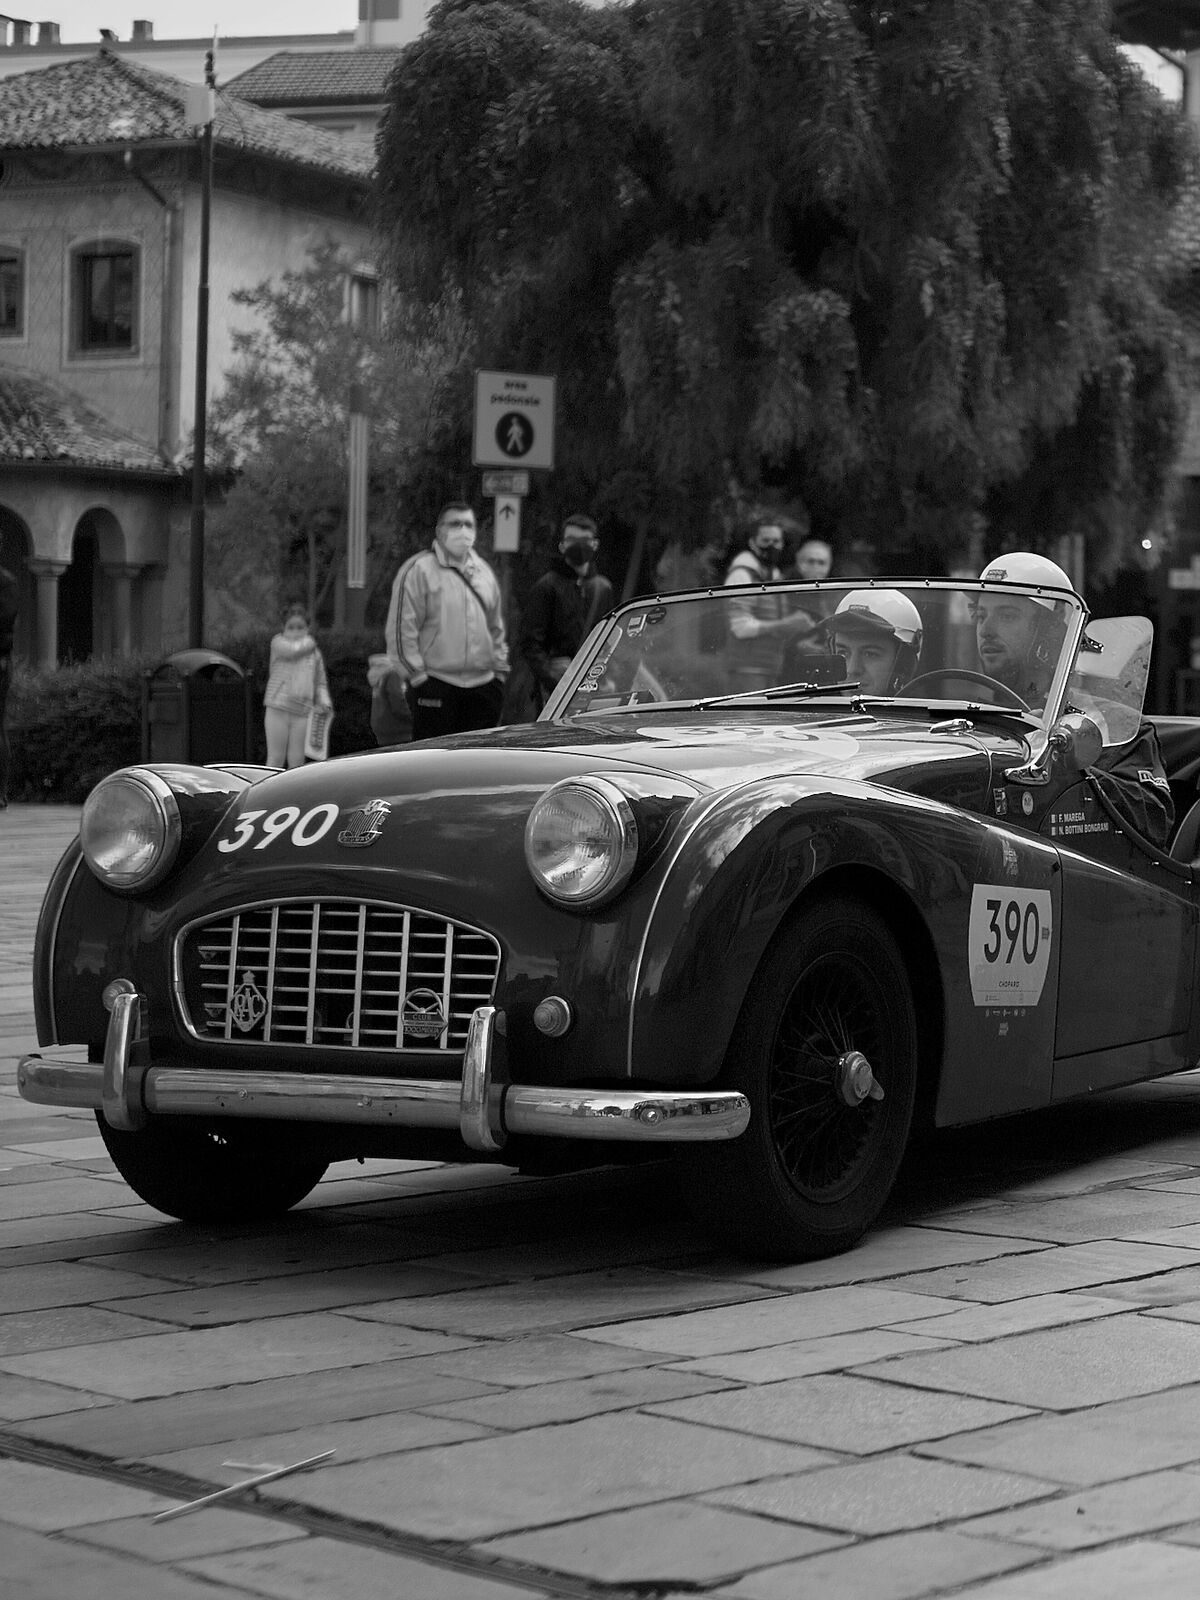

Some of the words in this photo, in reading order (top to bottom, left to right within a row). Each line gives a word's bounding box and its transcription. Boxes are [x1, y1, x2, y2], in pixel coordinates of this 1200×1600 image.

[490, 393, 541, 407] pedonale
[217, 803, 340, 853] 390
[1064, 812, 1086, 823] MAREGA
[984, 899, 1040, 964] 390
